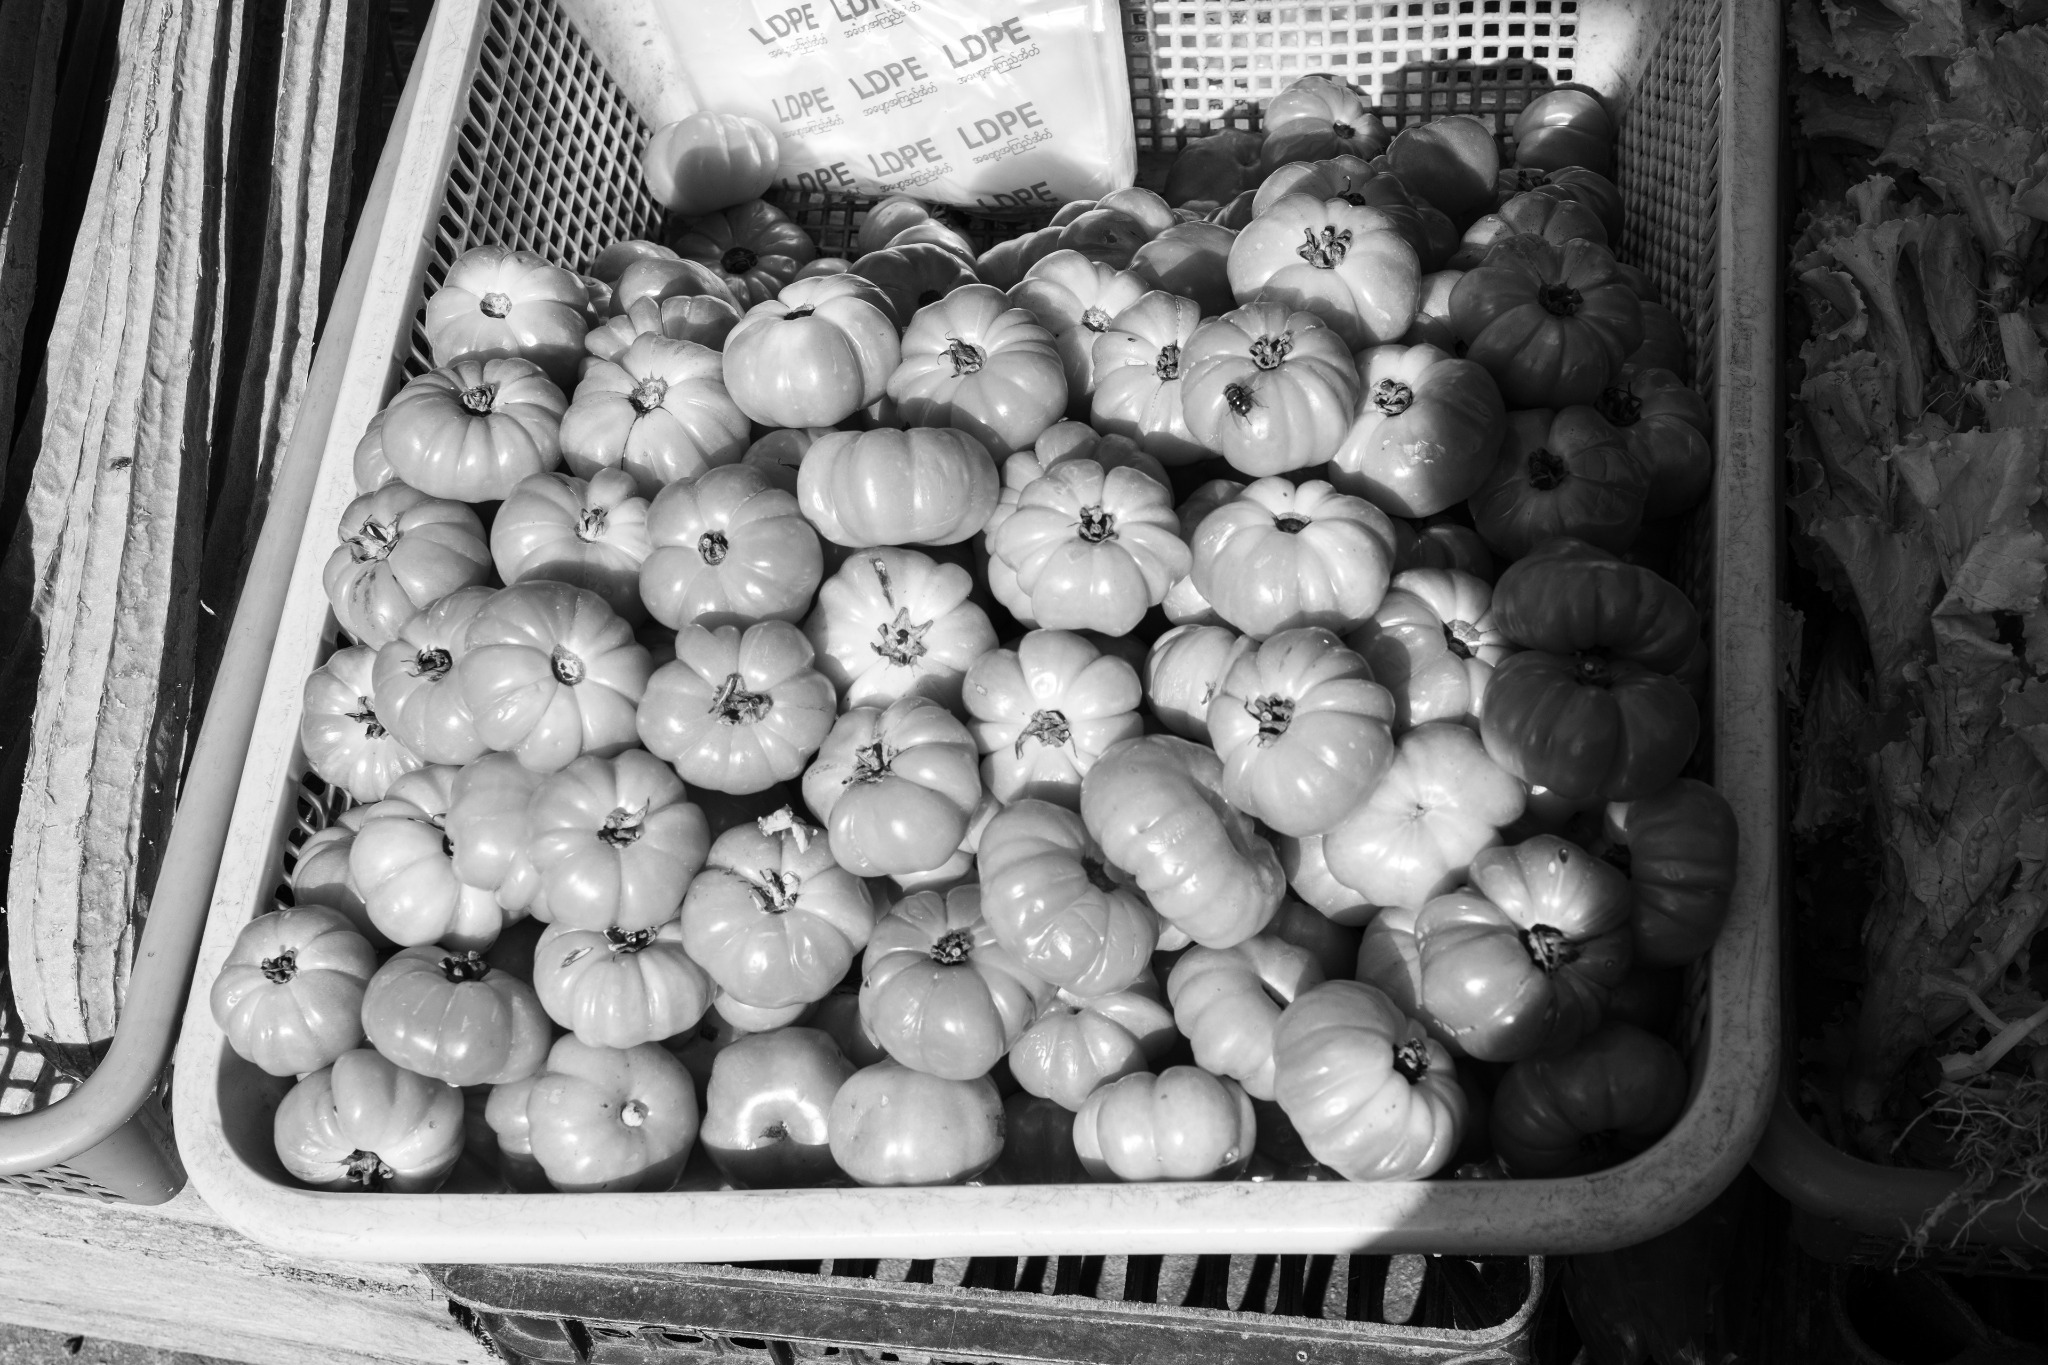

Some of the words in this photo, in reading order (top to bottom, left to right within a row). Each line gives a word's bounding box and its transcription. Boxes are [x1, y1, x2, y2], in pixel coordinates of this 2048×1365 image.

[748, 3, 820, 45] LDPE
[829, 0, 902, 22] LD
[942, 16, 1031, 69] LDPE
[848, 56, 929, 100] LDPE
[772, 87, 835, 123] LDPE
[957, 101, 1044, 150] LDPE
[867, 137, 943, 178] LDPE
